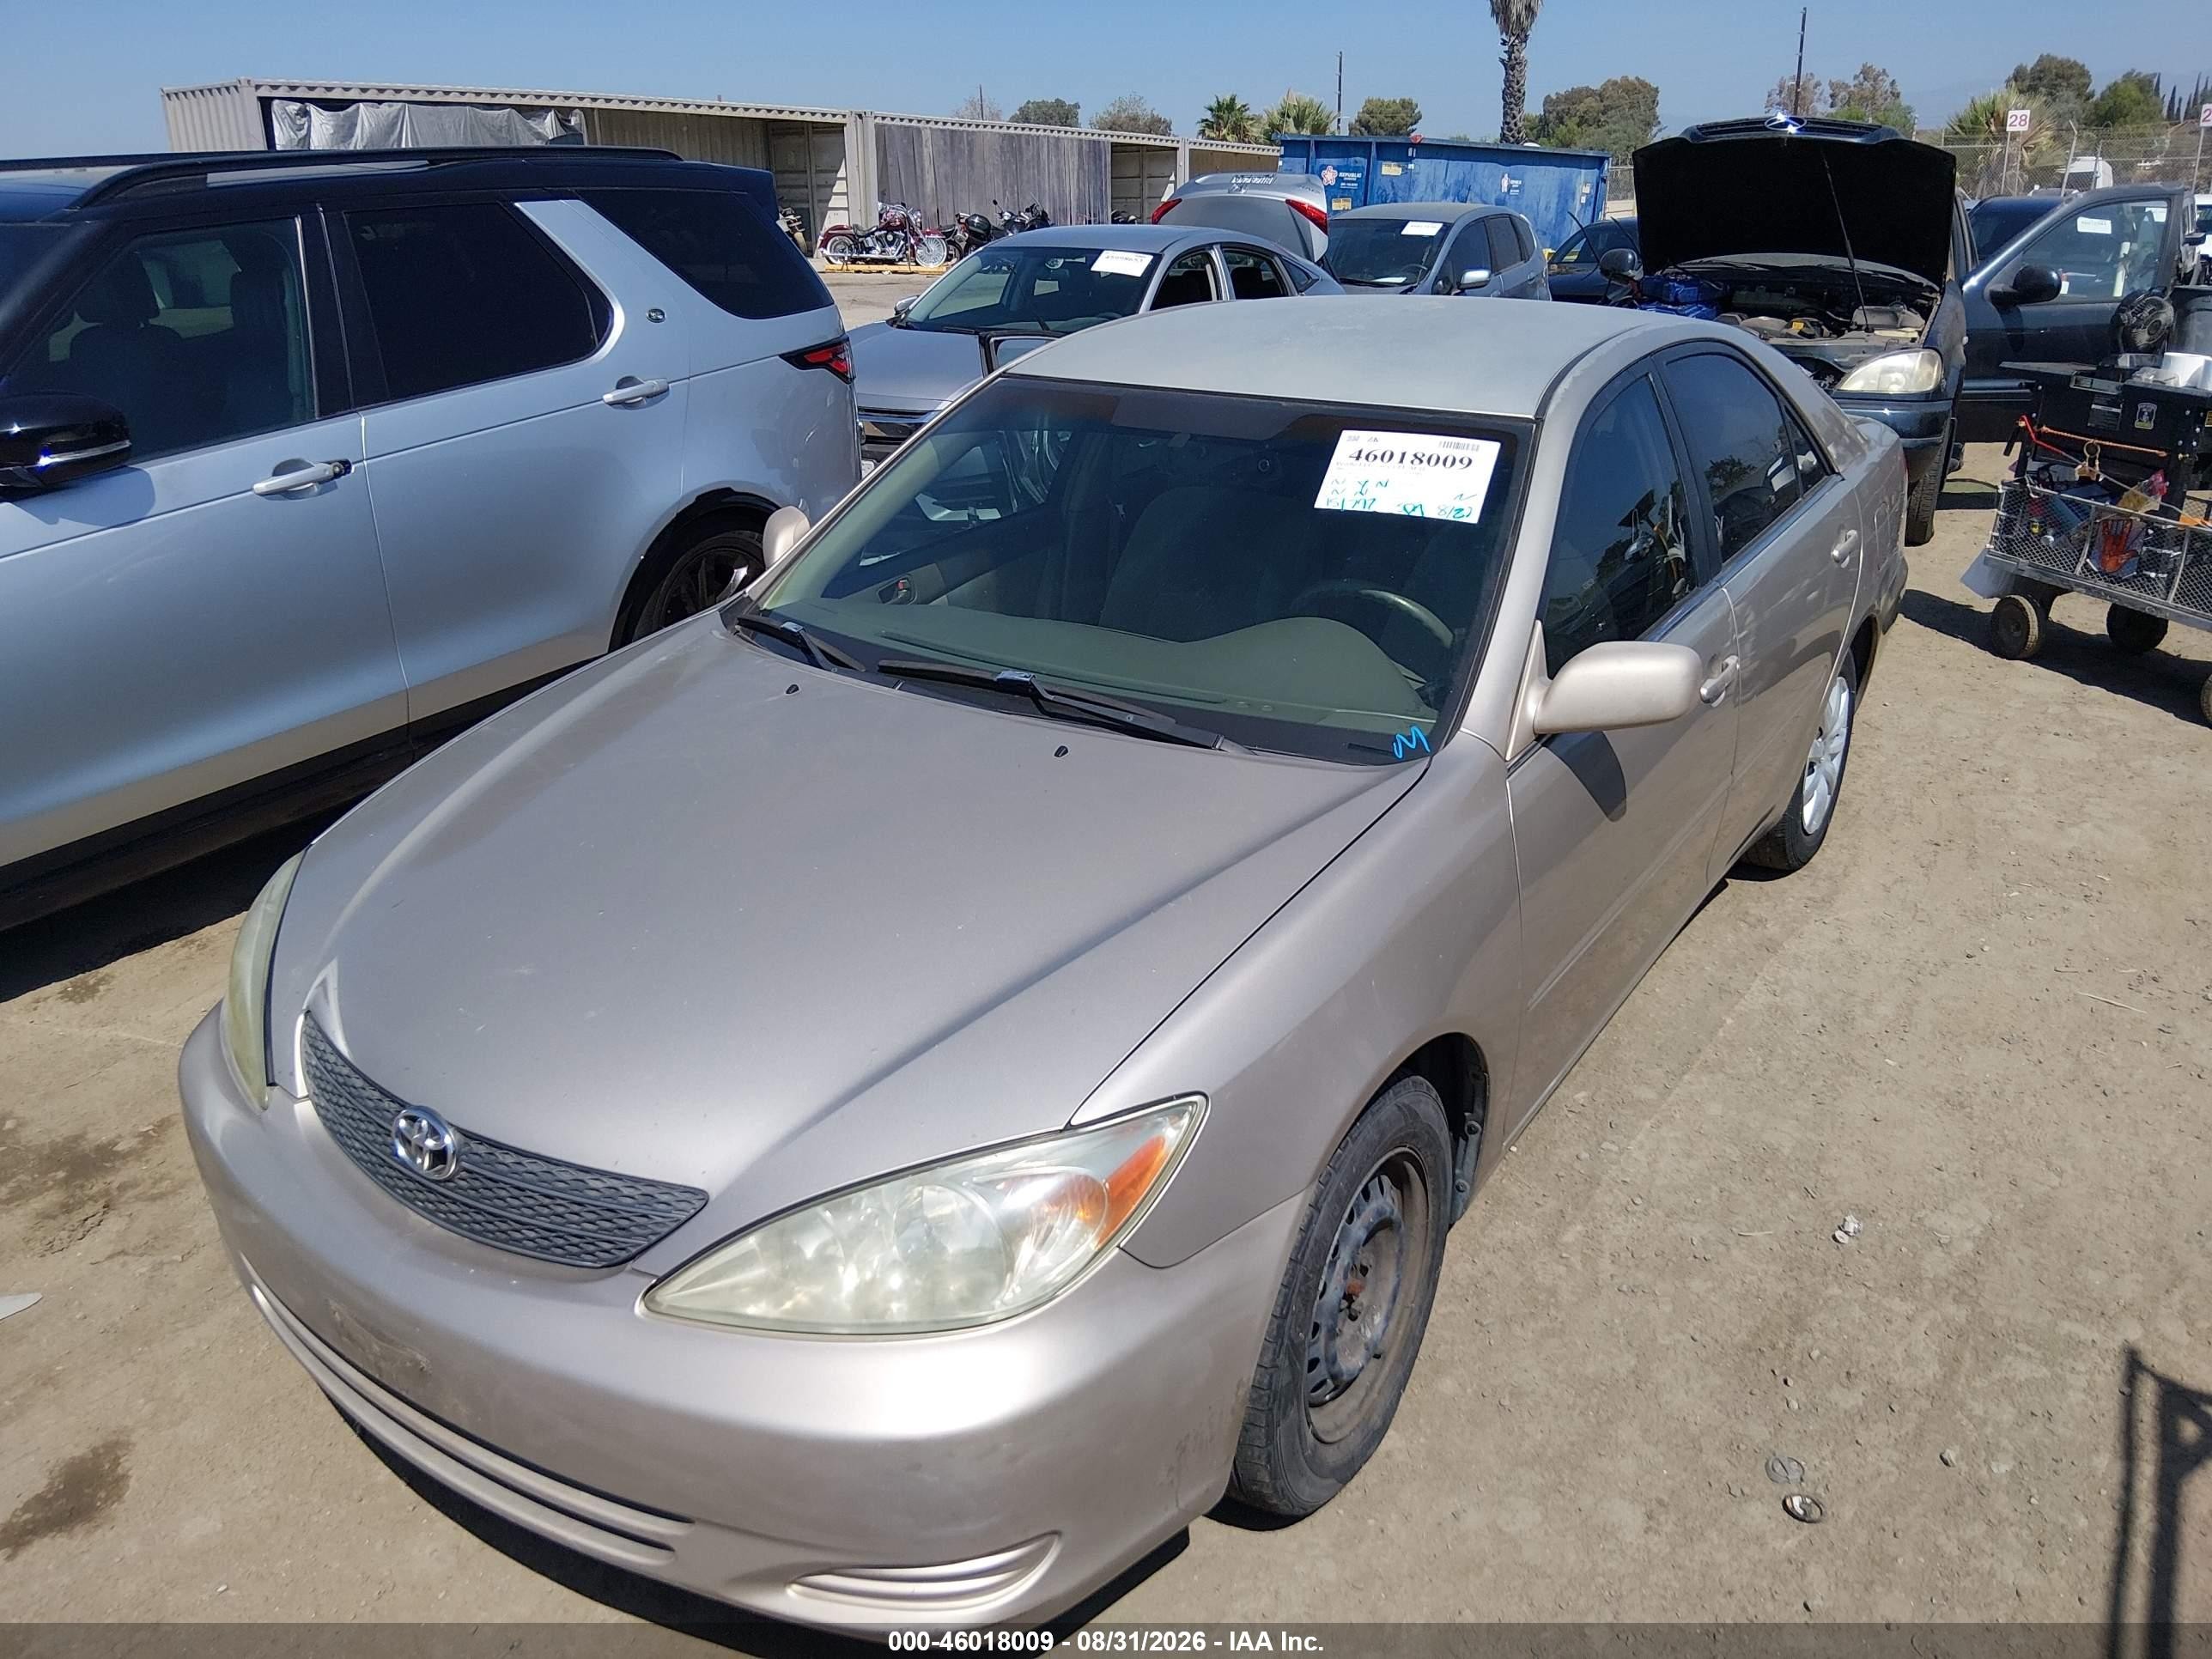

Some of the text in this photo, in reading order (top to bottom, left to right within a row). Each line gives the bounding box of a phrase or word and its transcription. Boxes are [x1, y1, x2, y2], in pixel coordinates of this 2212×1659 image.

[2008, 113, 2028, 127] 28
[2202, 108, 2212, 123] 2
[1349, 447, 1473, 471] 46018009
[1392, 725, 1431, 759] M
